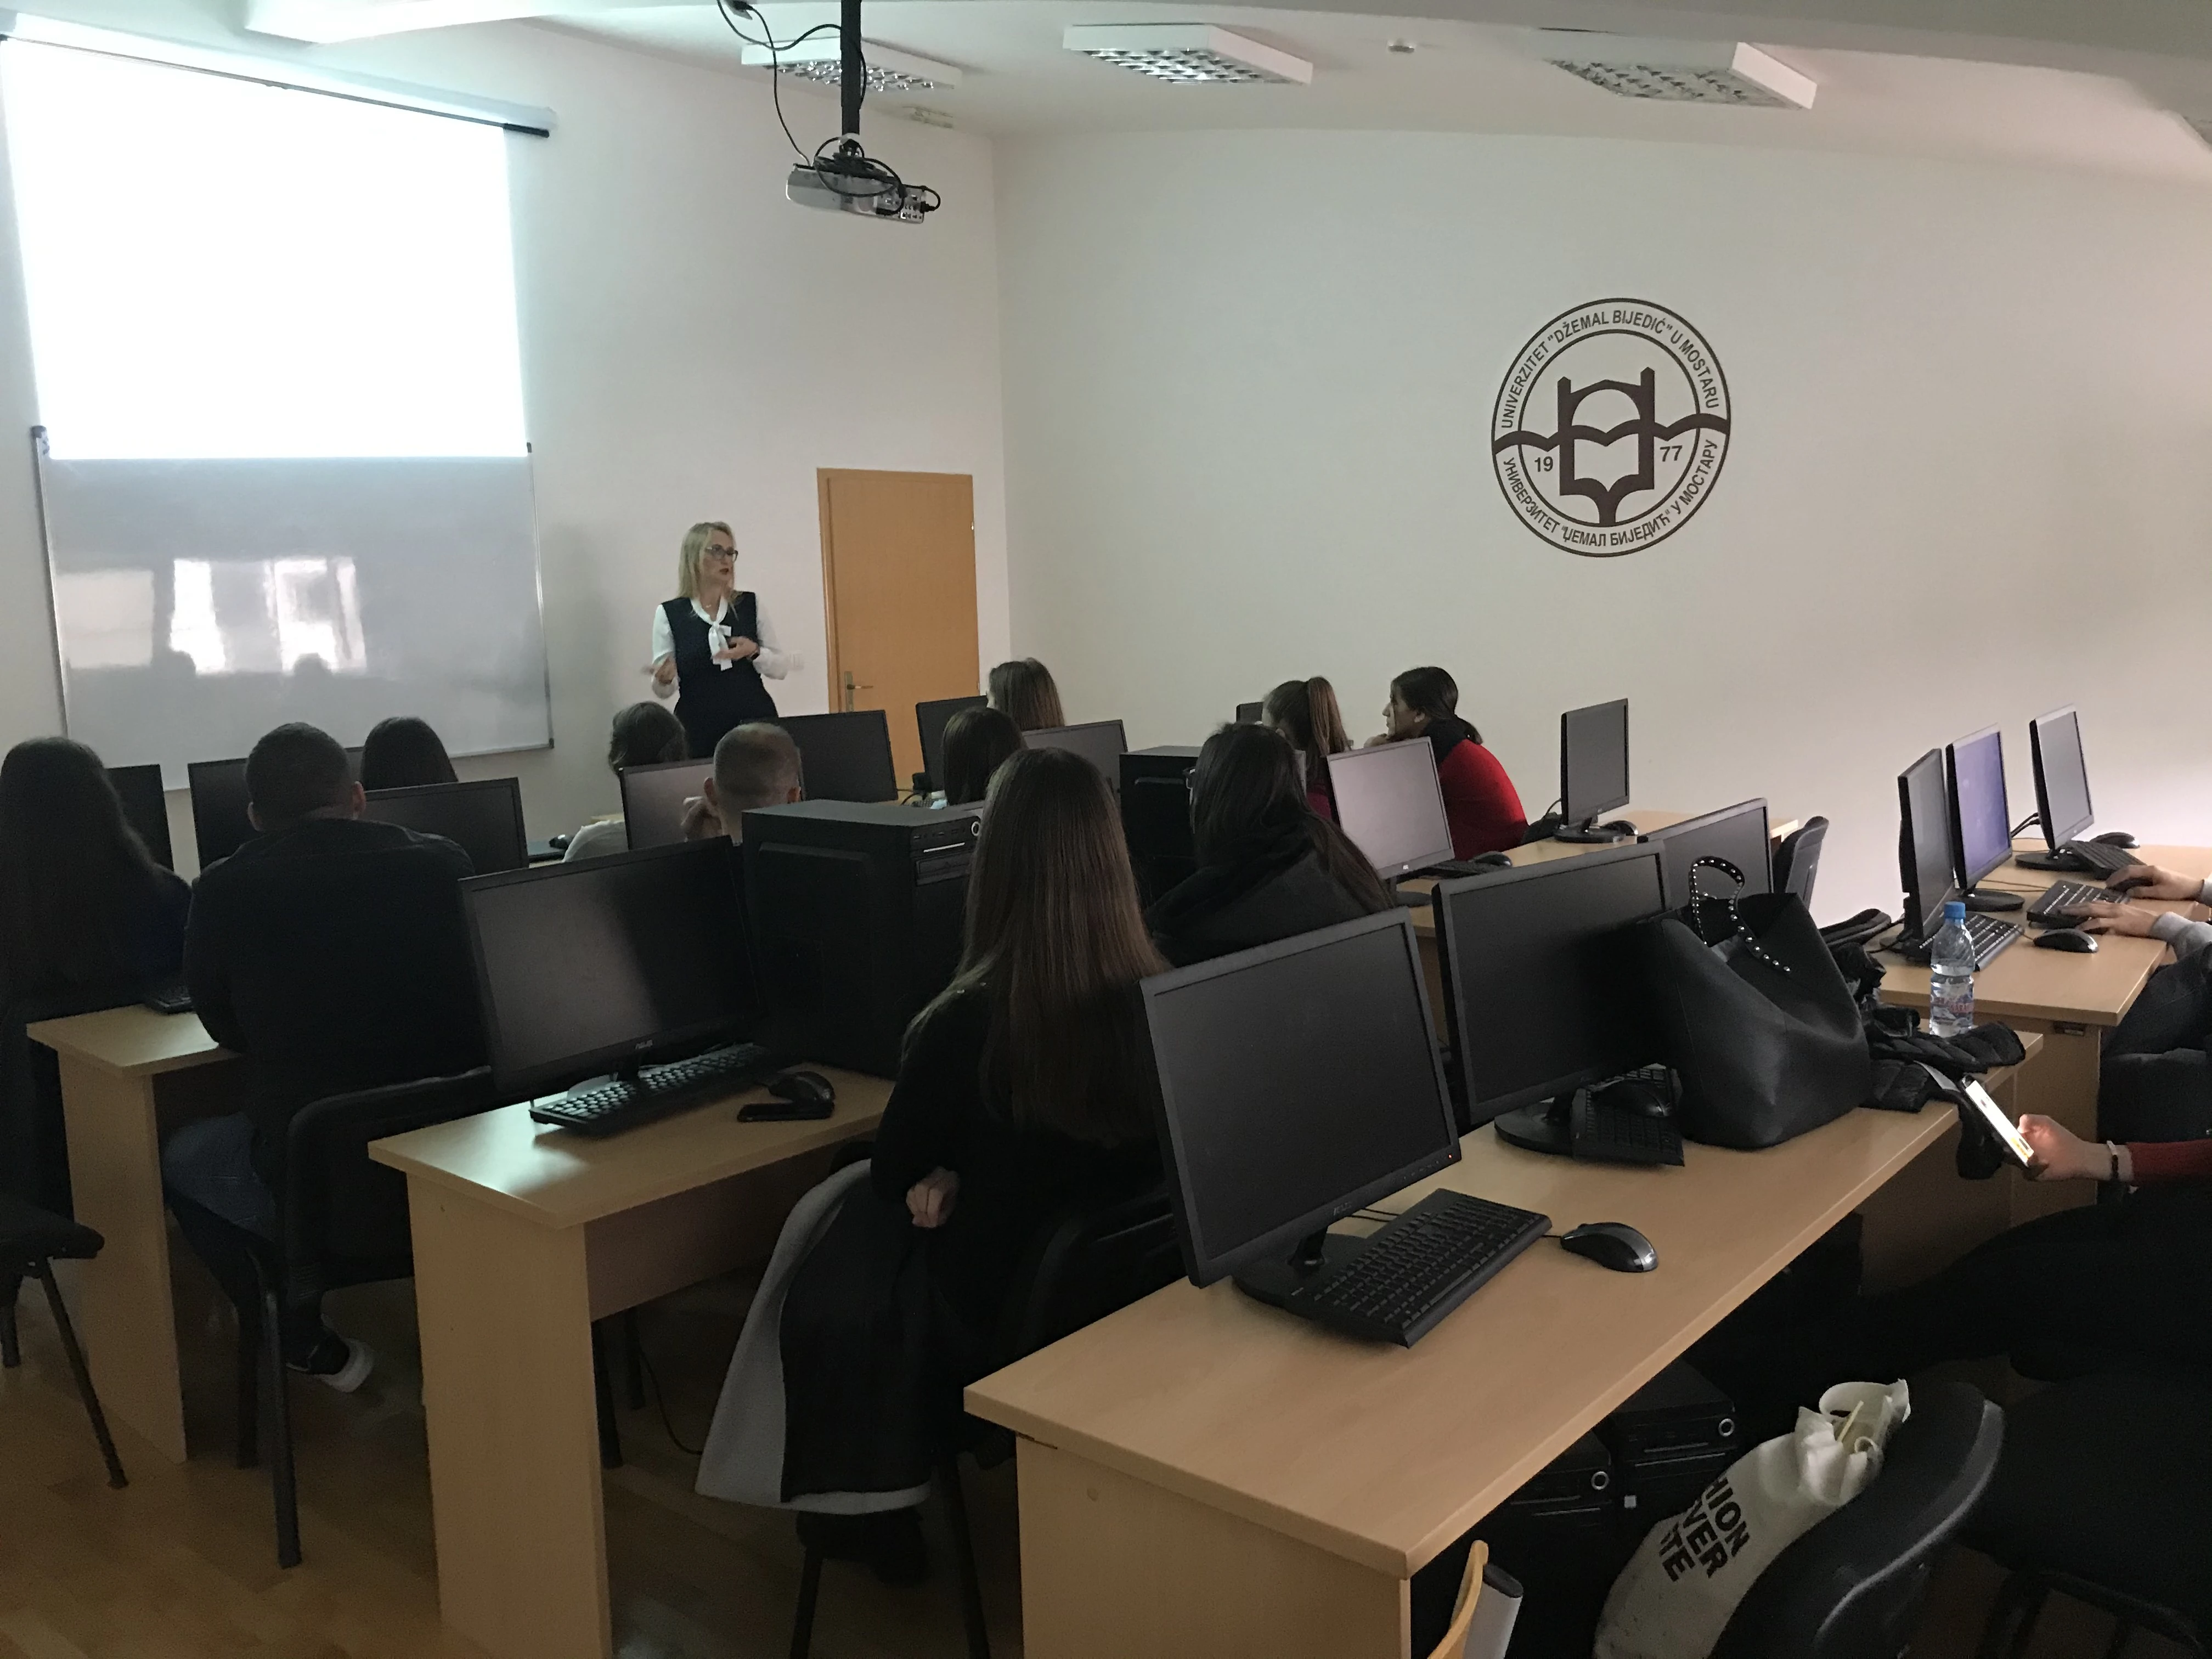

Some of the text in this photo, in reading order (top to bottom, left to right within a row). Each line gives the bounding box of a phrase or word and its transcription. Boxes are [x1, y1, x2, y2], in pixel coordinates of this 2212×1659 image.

[1501, 310, 1719, 428] UNIVERZITET "DŽEMAL BIJEDIĆ" U MOSTARU
[1503, 456, 1561, 533] УНИВЕРЗИТЕТ
[1669, 500, 1681, 515] У
[1678, 439, 1718, 506] МОСТАРУ
[1534, 445, 1683, 472] 19 77
